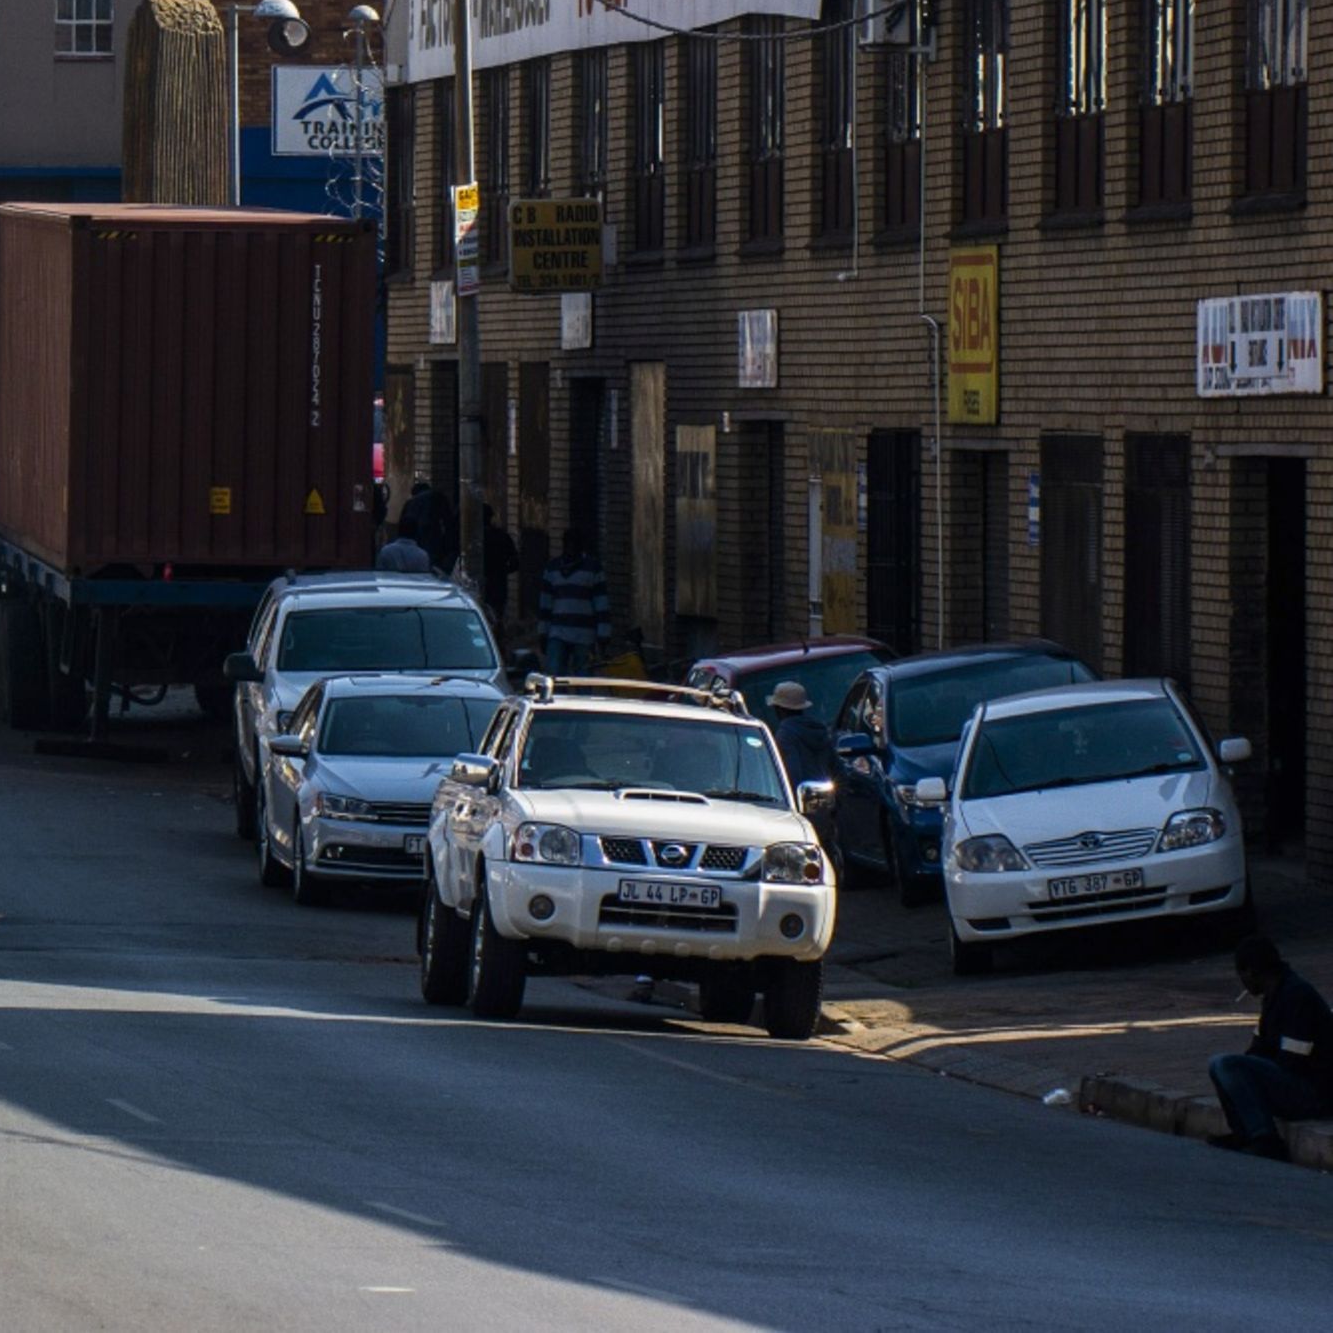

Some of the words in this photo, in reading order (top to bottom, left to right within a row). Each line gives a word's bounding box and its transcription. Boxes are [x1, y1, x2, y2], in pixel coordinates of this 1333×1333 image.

[300, 121, 384, 135] TRAININ
[556, 204, 598, 223] RADIO
[514, 227, 600, 247] INSTALLATION
[533, 251, 589, 270] CENTRE
[952, 276, 991, 352] SIBA
[1123, 871, 1140, 887] GP
[623, 882, 640, 900] JL
[646, 884, 663, 902] 44
[670, 886, 688, 903] LP
[701, 888, 718, 905] GP
